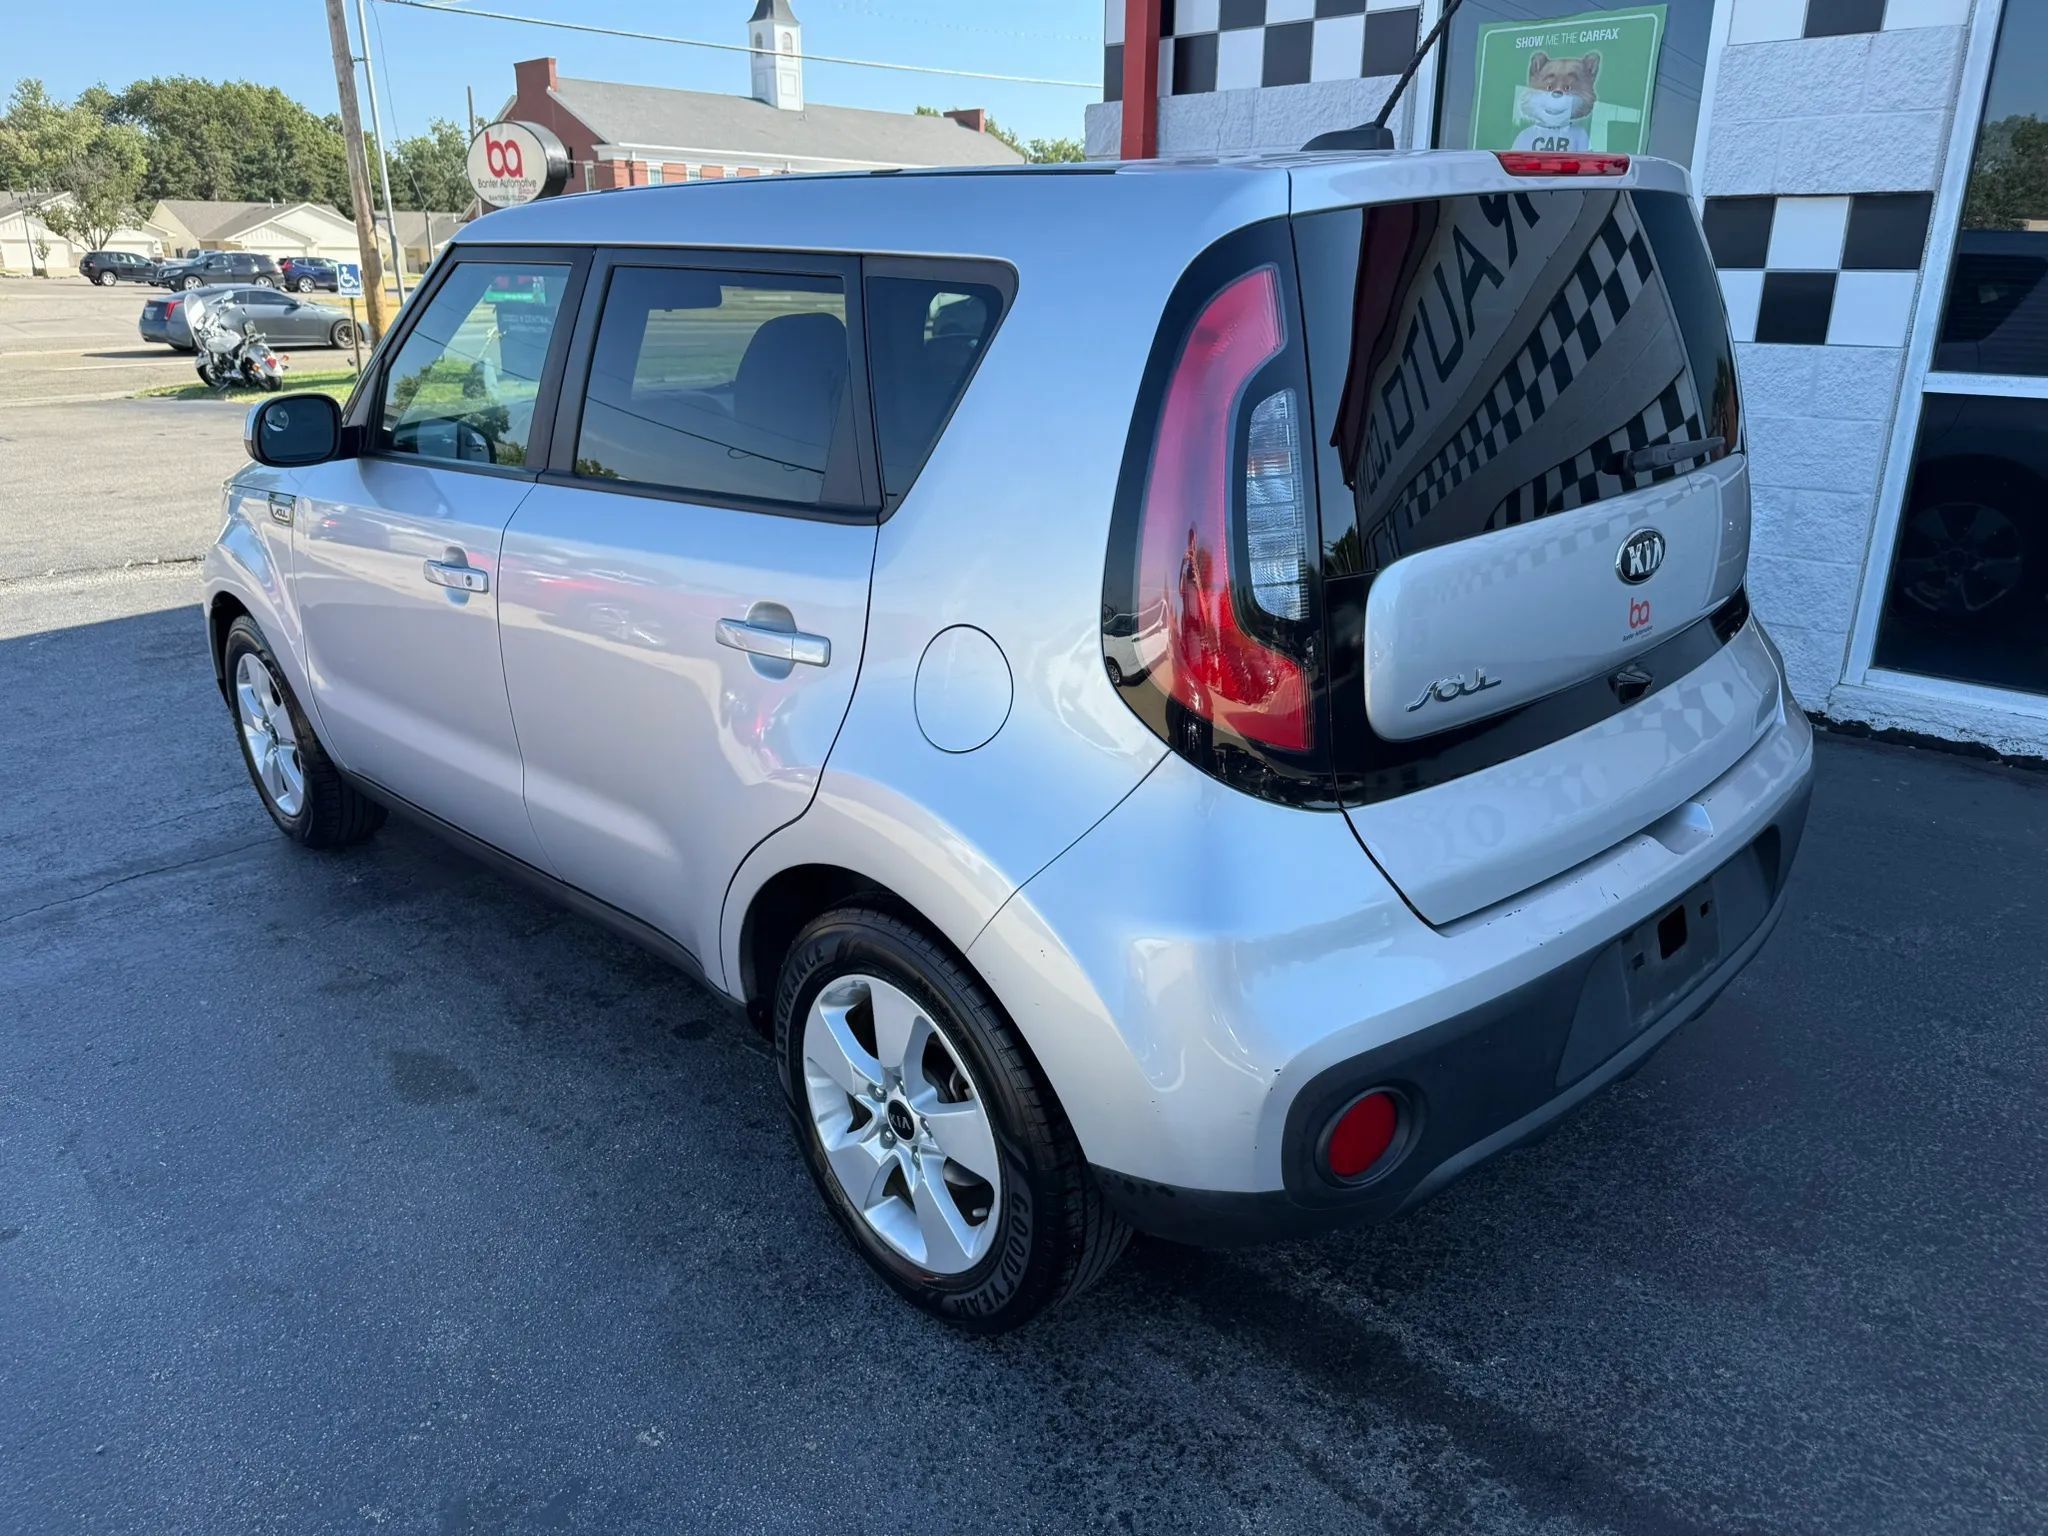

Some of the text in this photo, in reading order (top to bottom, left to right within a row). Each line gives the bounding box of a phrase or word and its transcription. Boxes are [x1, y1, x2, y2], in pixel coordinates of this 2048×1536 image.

[1515, 28, 1620, 48] SHOW ME THE CARFAX
[485, 131, 523, 178] ba
[1531, 137, 1570, 152] CAR
[477, 178, 537, 189] Banter Automotive
[1627, 537, 1663, 577] KIA
[888, 1112, 912, 1131] KIA
[954, 1191, 1029, 1316] GOODYEAR
